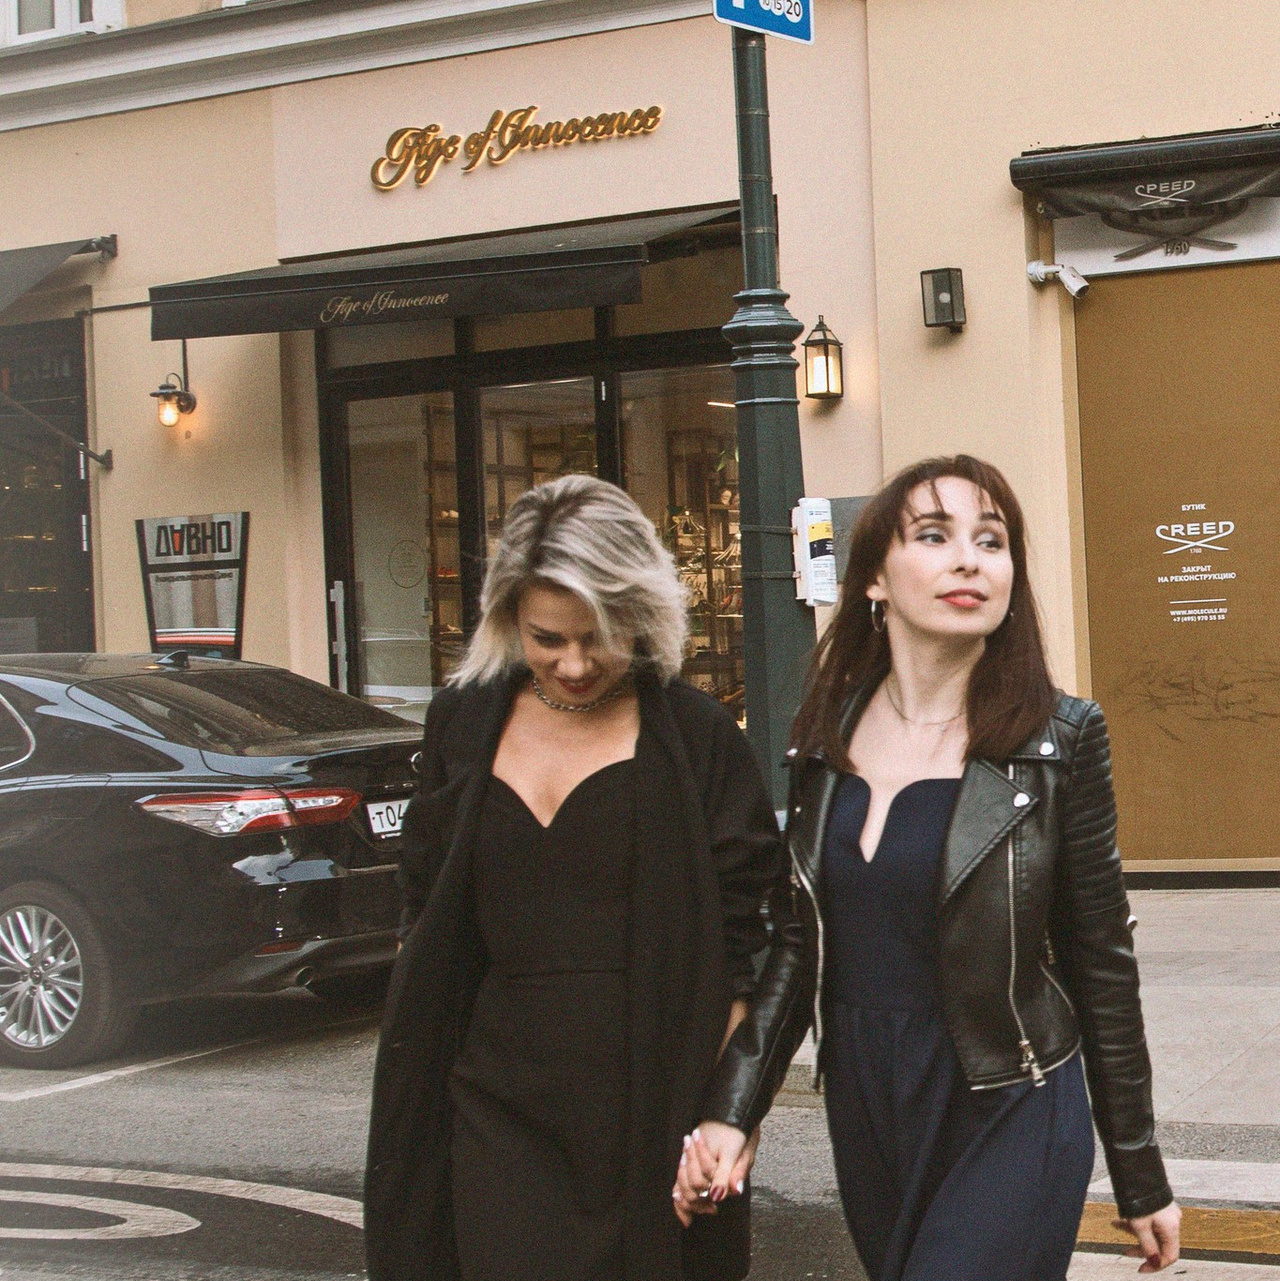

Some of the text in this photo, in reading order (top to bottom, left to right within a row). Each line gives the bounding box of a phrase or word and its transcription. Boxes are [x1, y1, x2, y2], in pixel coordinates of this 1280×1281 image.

[786, 0, 801, 17] 20
[370, 105, 662, 189] Age of Innocence
[362, 291, 380, 315] of
[373, 290, 449, 315] Innocence
[1155, 521, 1235, 537] CREED
[1182, 565, 1212, 573] ЗАКРЫТ
[1170, 572, 1236, 583] РЕКОНСТРУКЦИЮ
